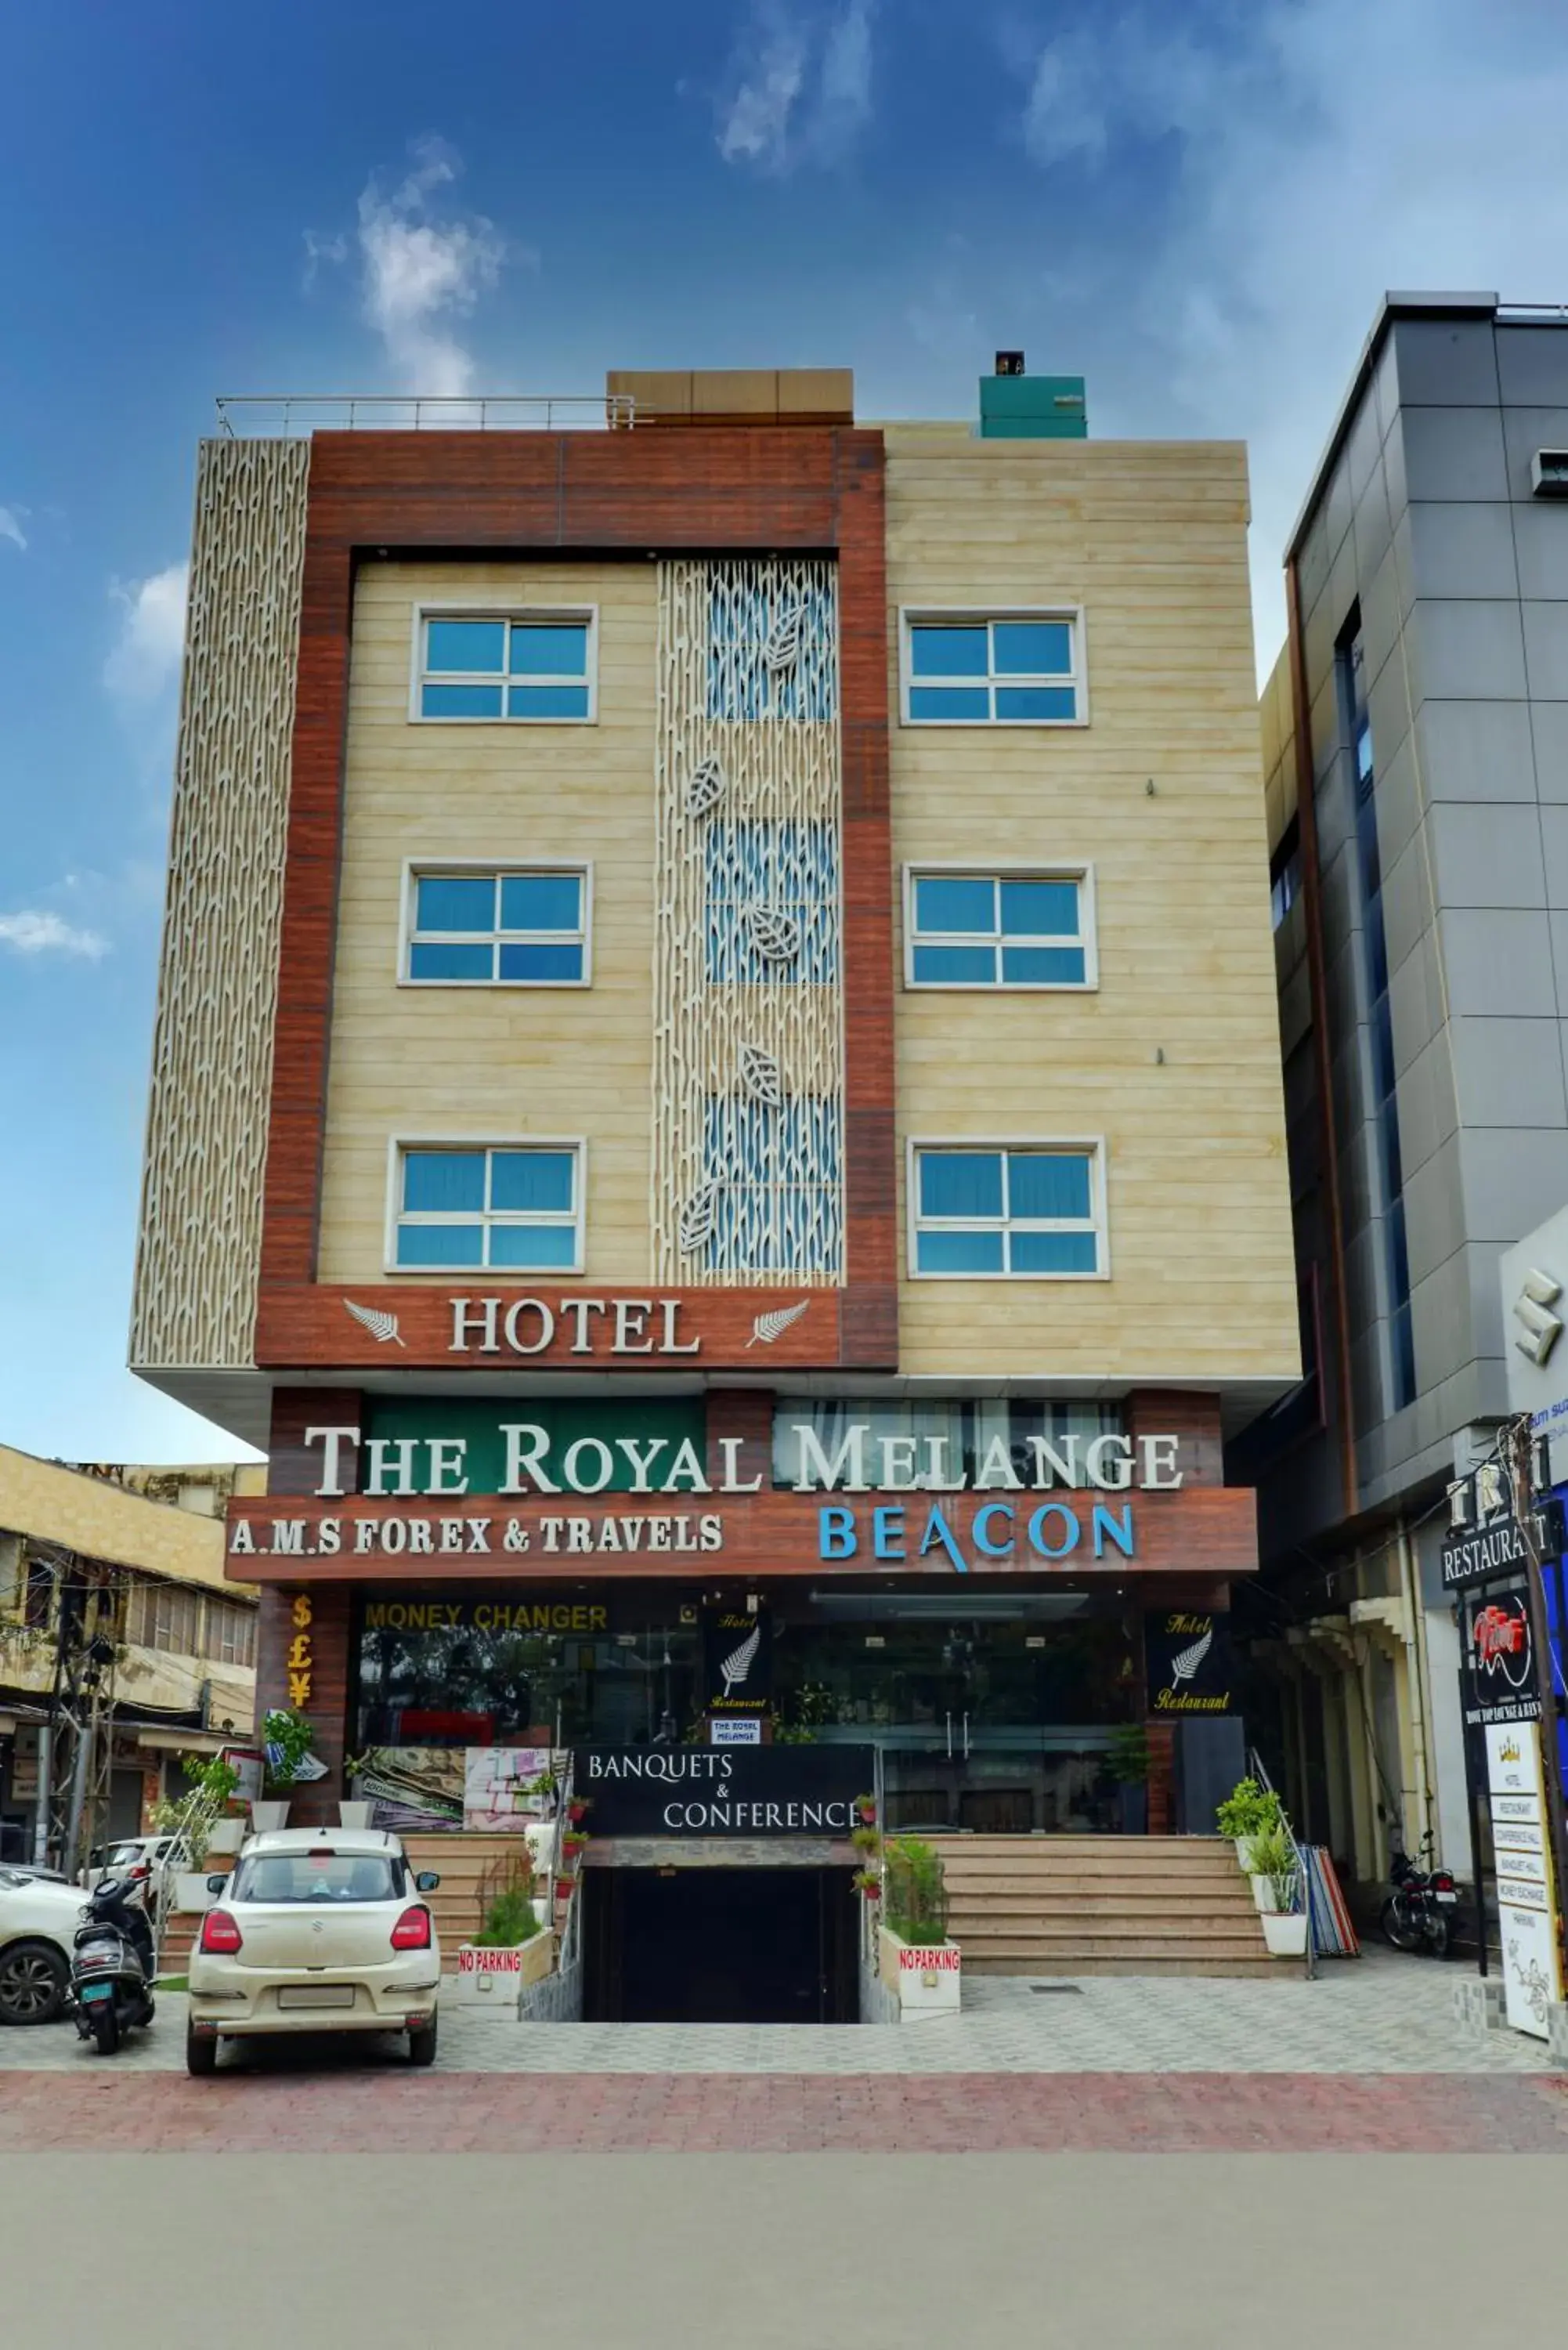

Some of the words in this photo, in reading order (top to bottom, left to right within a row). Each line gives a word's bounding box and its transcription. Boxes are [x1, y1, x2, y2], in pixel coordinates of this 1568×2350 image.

[448, 1298, 700, 1354] HOTEL
[305, 1426, 469, 1496] THE
[497, 1423, 763, 1494] ROYAL
[792, 1425, 1183, 1492] MELANGE
[229, 1518, 341, 1555] A.M.S
[353, 1517, 492, 1554] FOREX
[503, 1517, 529, 1553] &
[540, 1513, 723, 1553] TRAVELS
[818, 1502, 1134, 1573] BEACON
[1443, 1514, 1547, 1582] RESTAURAT
[365, 1603, 463, 1629] MONEY
[474, 1604, 607, 1630] CHANGER
[1165, 1614, 1211, 1635] Hotel
[1153, 1688, 1230, 1712] Restaurant
[589, 1754, 733, 1783] BANQUETS
[716, 1784, 729, 1798] &
[663, 1802, 860, 1828] CONFERENCE
[459, 1951, 473, 1971] NO
[475, 1950, 521, 1971] PARKING
[900, 1950, 914, 1970] NO
[916, 1950, 959, 1970] PARKING
